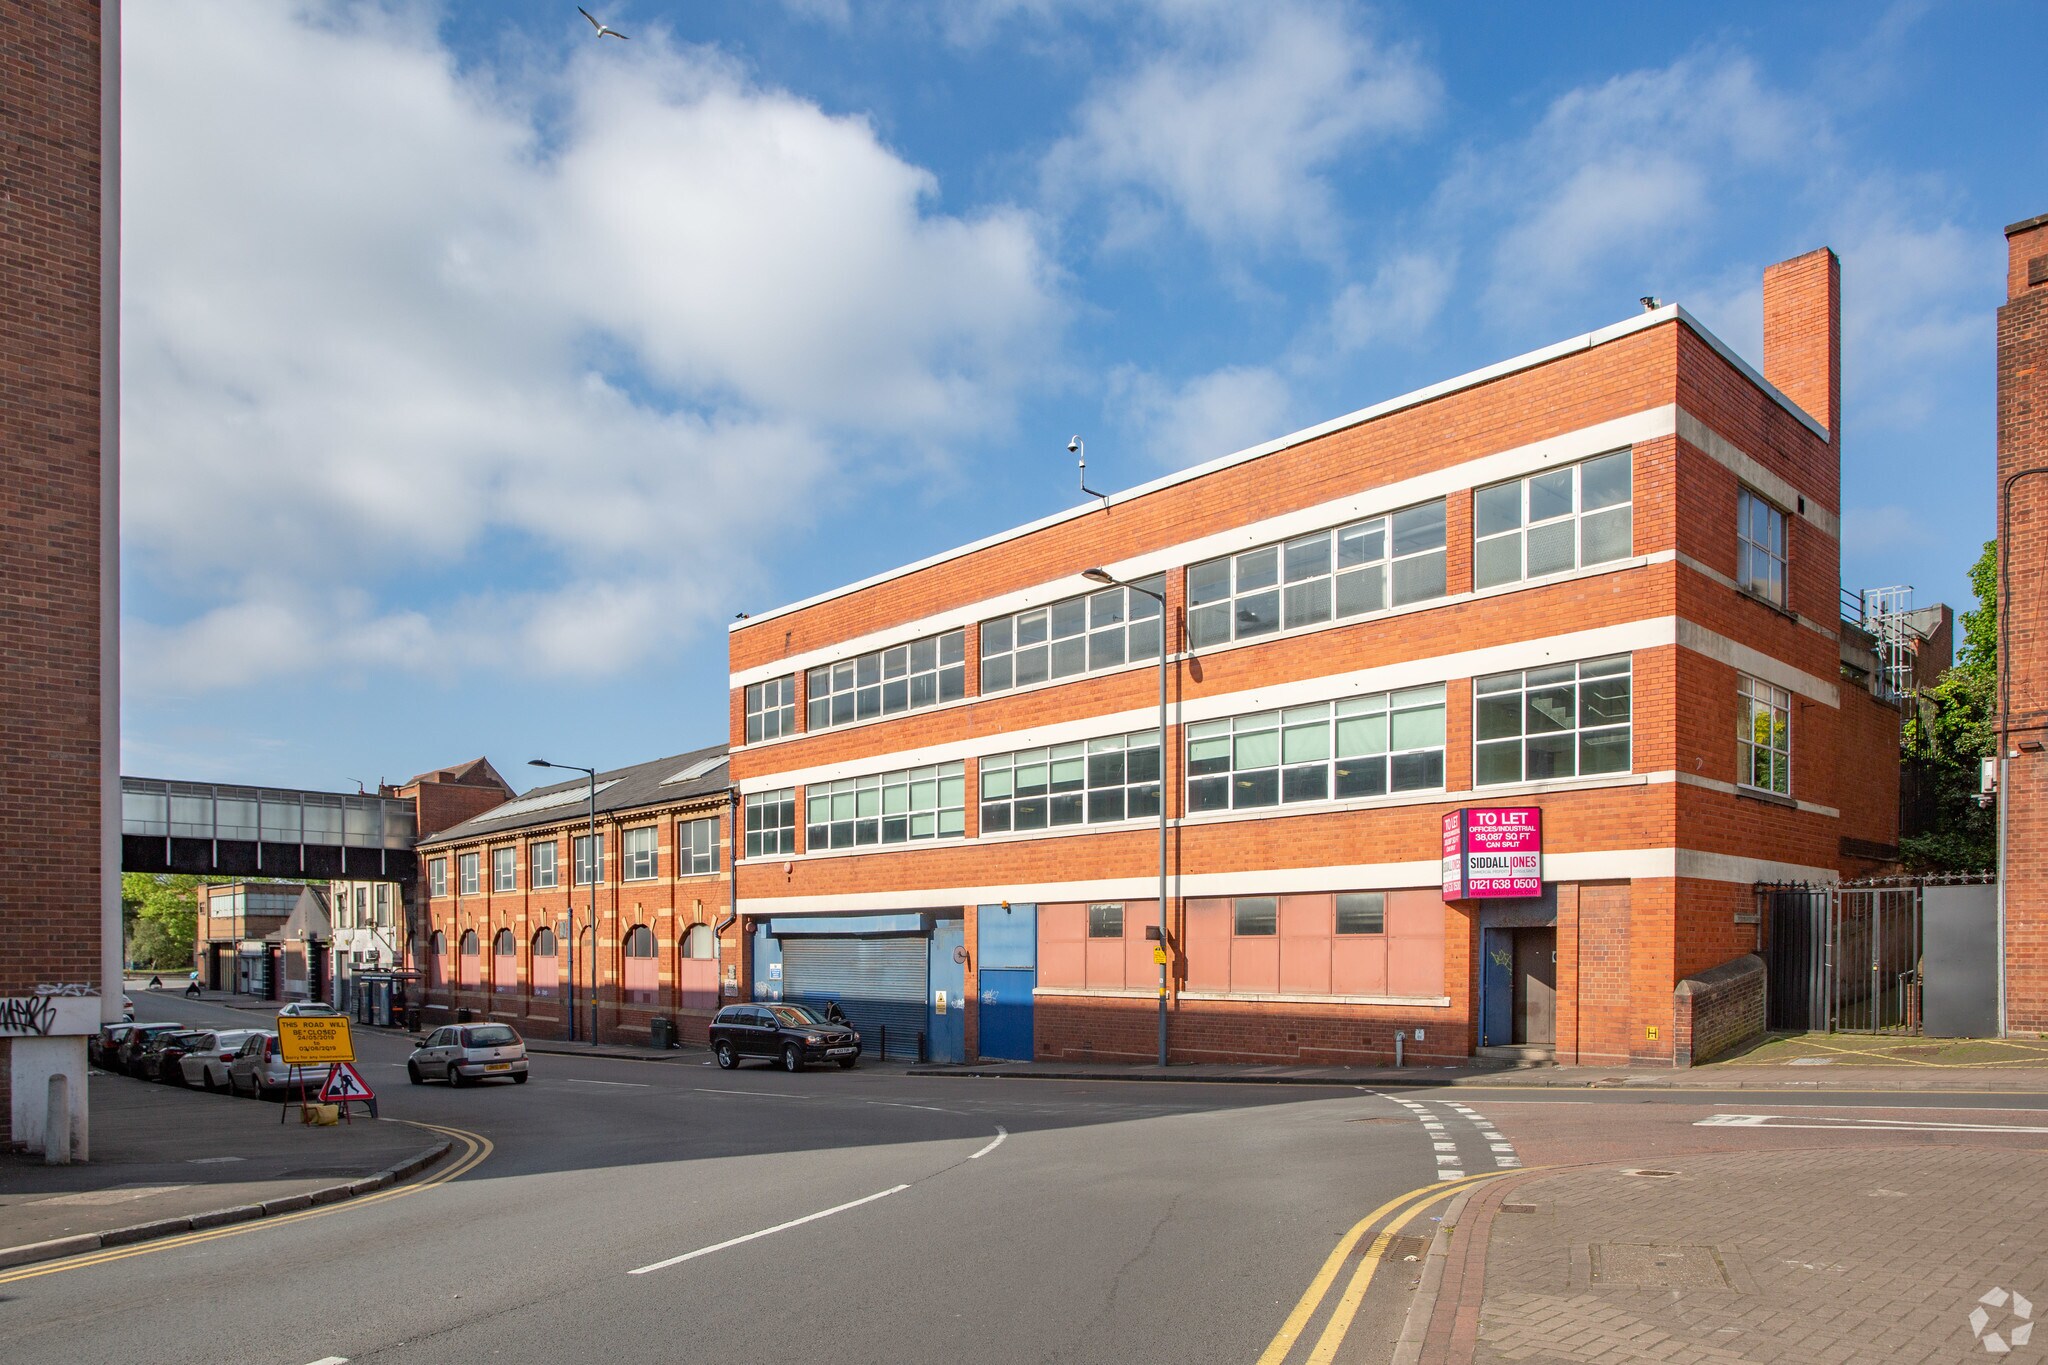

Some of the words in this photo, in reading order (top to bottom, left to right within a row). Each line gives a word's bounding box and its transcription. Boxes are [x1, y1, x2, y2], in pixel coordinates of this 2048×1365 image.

[1476, 812, 1497, 825] TO
[1501, 812, 1528, 825] LET
[1475, 833, 1503, 841] 38,087
[1470, 857, 1509, 869] SIDDALL
[1509, 856, 1536, 876] JONES
[1470, 880, 1490, 890] 0121
[1492, 880, 1511, 889] 638
[1514, 879, 1538, 888] 0500
